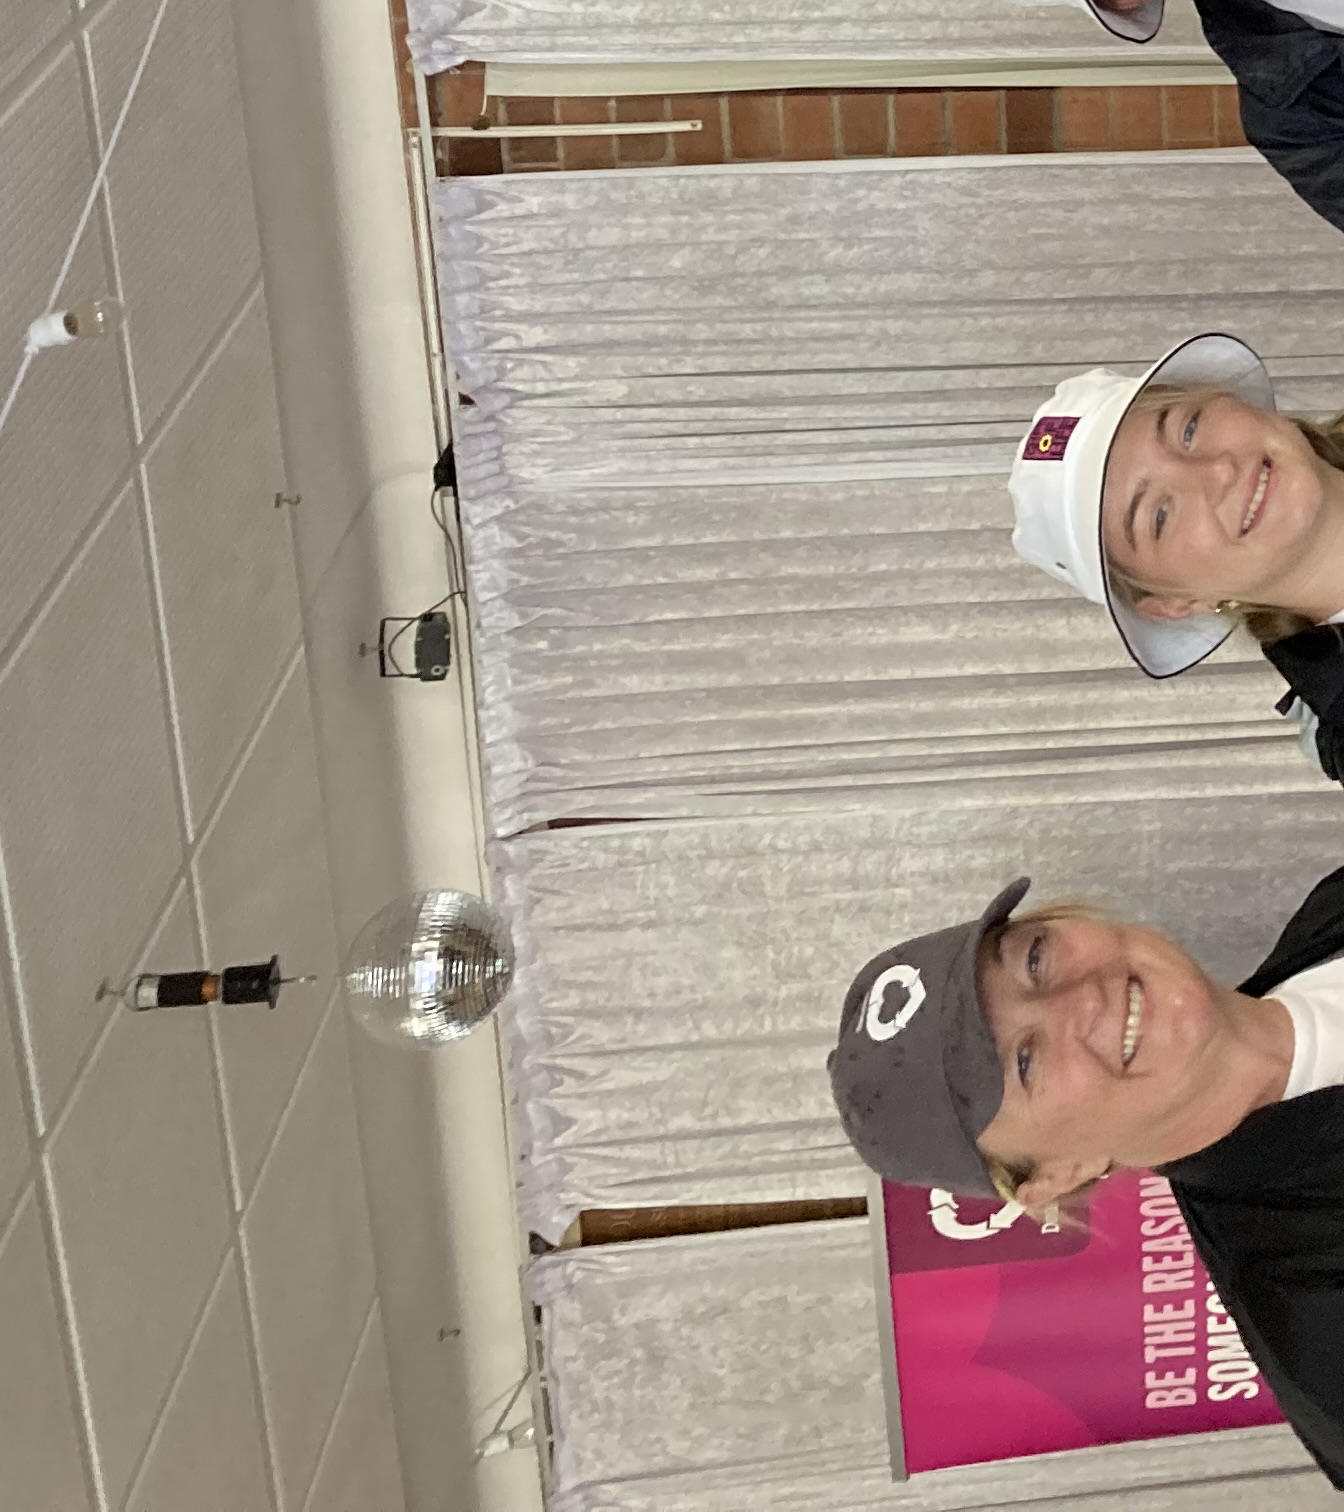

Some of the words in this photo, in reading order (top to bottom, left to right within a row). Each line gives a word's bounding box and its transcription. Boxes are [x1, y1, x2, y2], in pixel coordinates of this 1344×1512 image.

[1139, 1176, 1195, 1293] REASON
[1143, 1299, 1196, 1363] THE
[1145, 1367, 1197, 1408] BE
